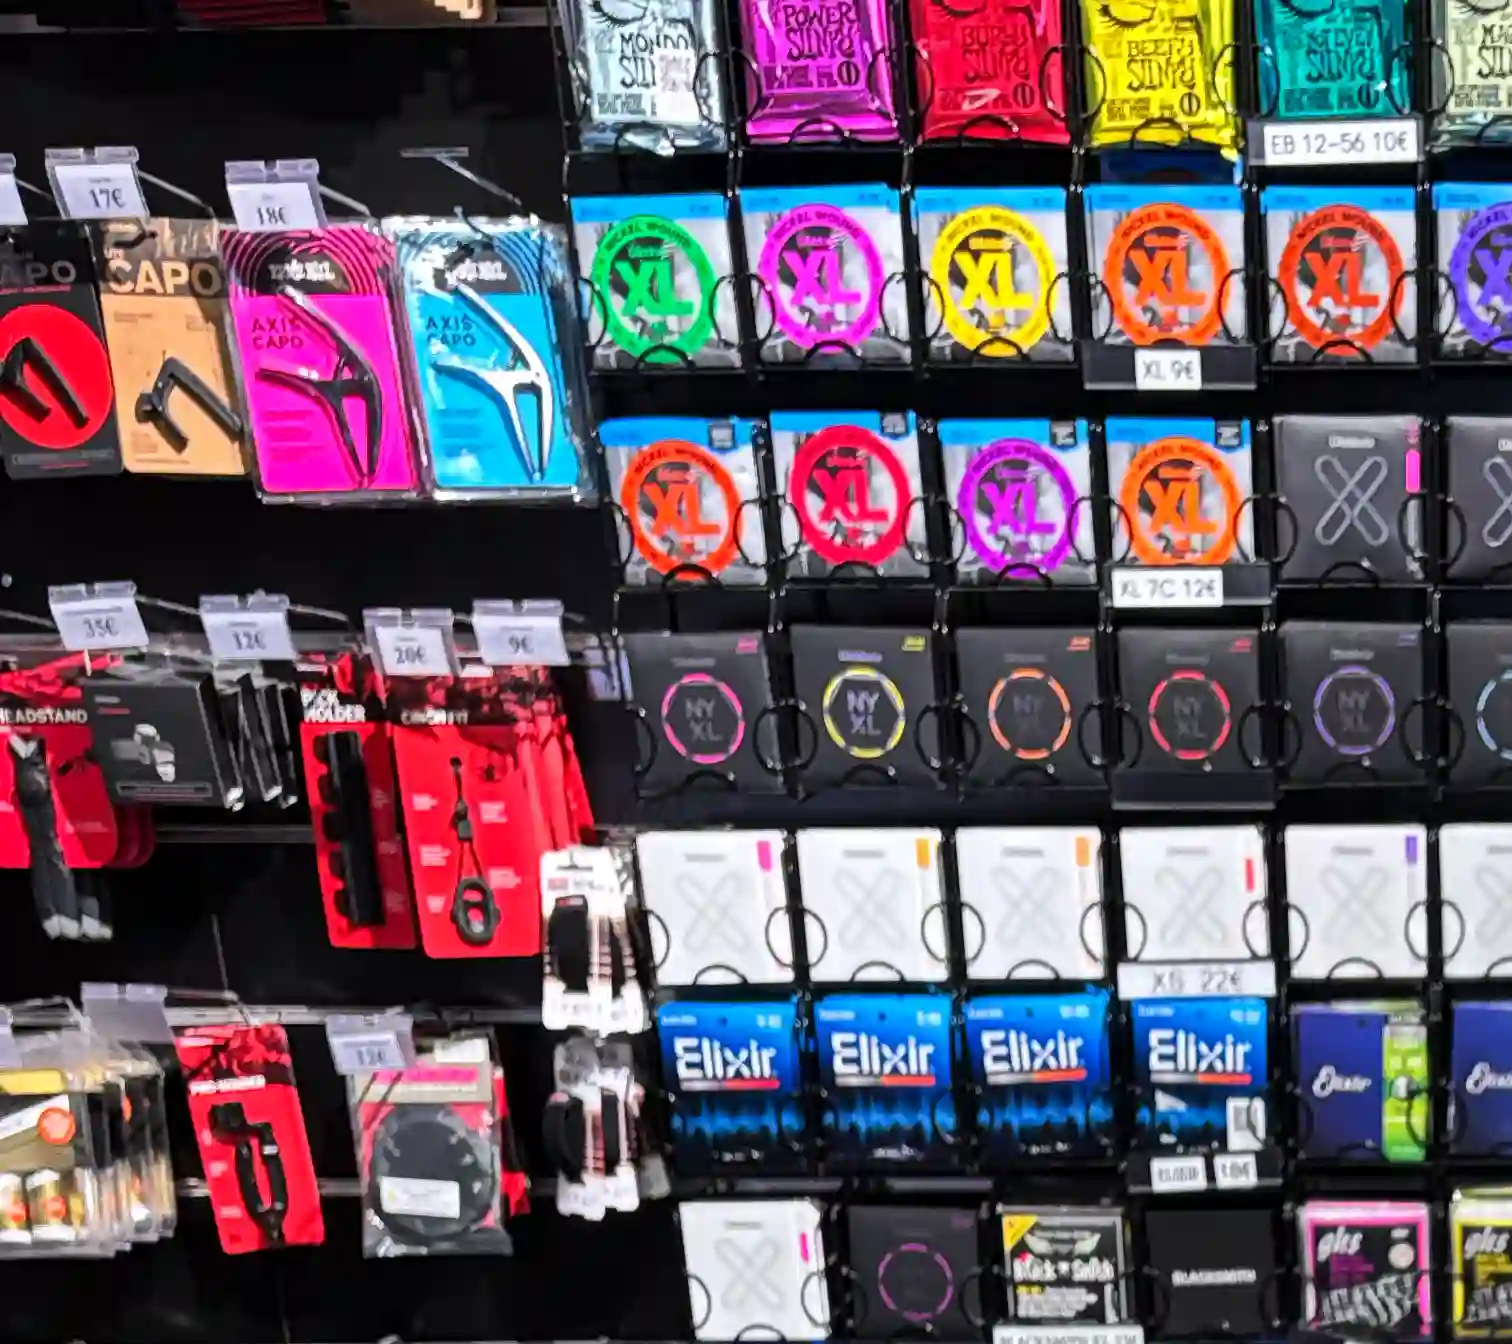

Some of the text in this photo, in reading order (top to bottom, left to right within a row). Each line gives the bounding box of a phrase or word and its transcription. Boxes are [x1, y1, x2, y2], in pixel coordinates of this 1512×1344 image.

[783, 2, 859, 26] POWER
[1272, 131, 1408, 155] EB 12-56 10€
[89, 188, 125, 209] 17€
[108, 259, 222, 296] CAPO
[615, 259, 694, 317] XL
[782, 250, 861, 306] XL
[957, 252, 1033, 308] XL
[1129, 249, 1207, 307] XL
[1305, 252, 1379, 307] XL
[252, 335, 305, 350] CAPO
[425, 314, 474, 331] AXIS
[1171, 358, 1194, 380] 9€
[641, 482, 720, 536] XL
[812, 468, 889, 522] XL
[981, 482, 1056, 534] XL
[1141, 481, 1217, 535] XL
[1147, 579, 1176, 597] 7C
[1183, 578, 1216, 597] 12€
[233, 631, 268, 651] 12€
[508, 635, 534, 655] 9€
[1201, 969, 1242, 993] 22€
[674, 1037, 777, 1080] Elixir
[831, 1032, 936, 1075] Elixir
[981, 1030, 1084, 1072] Elixir
[1149, 1028, 1252, 1074] Elixir
